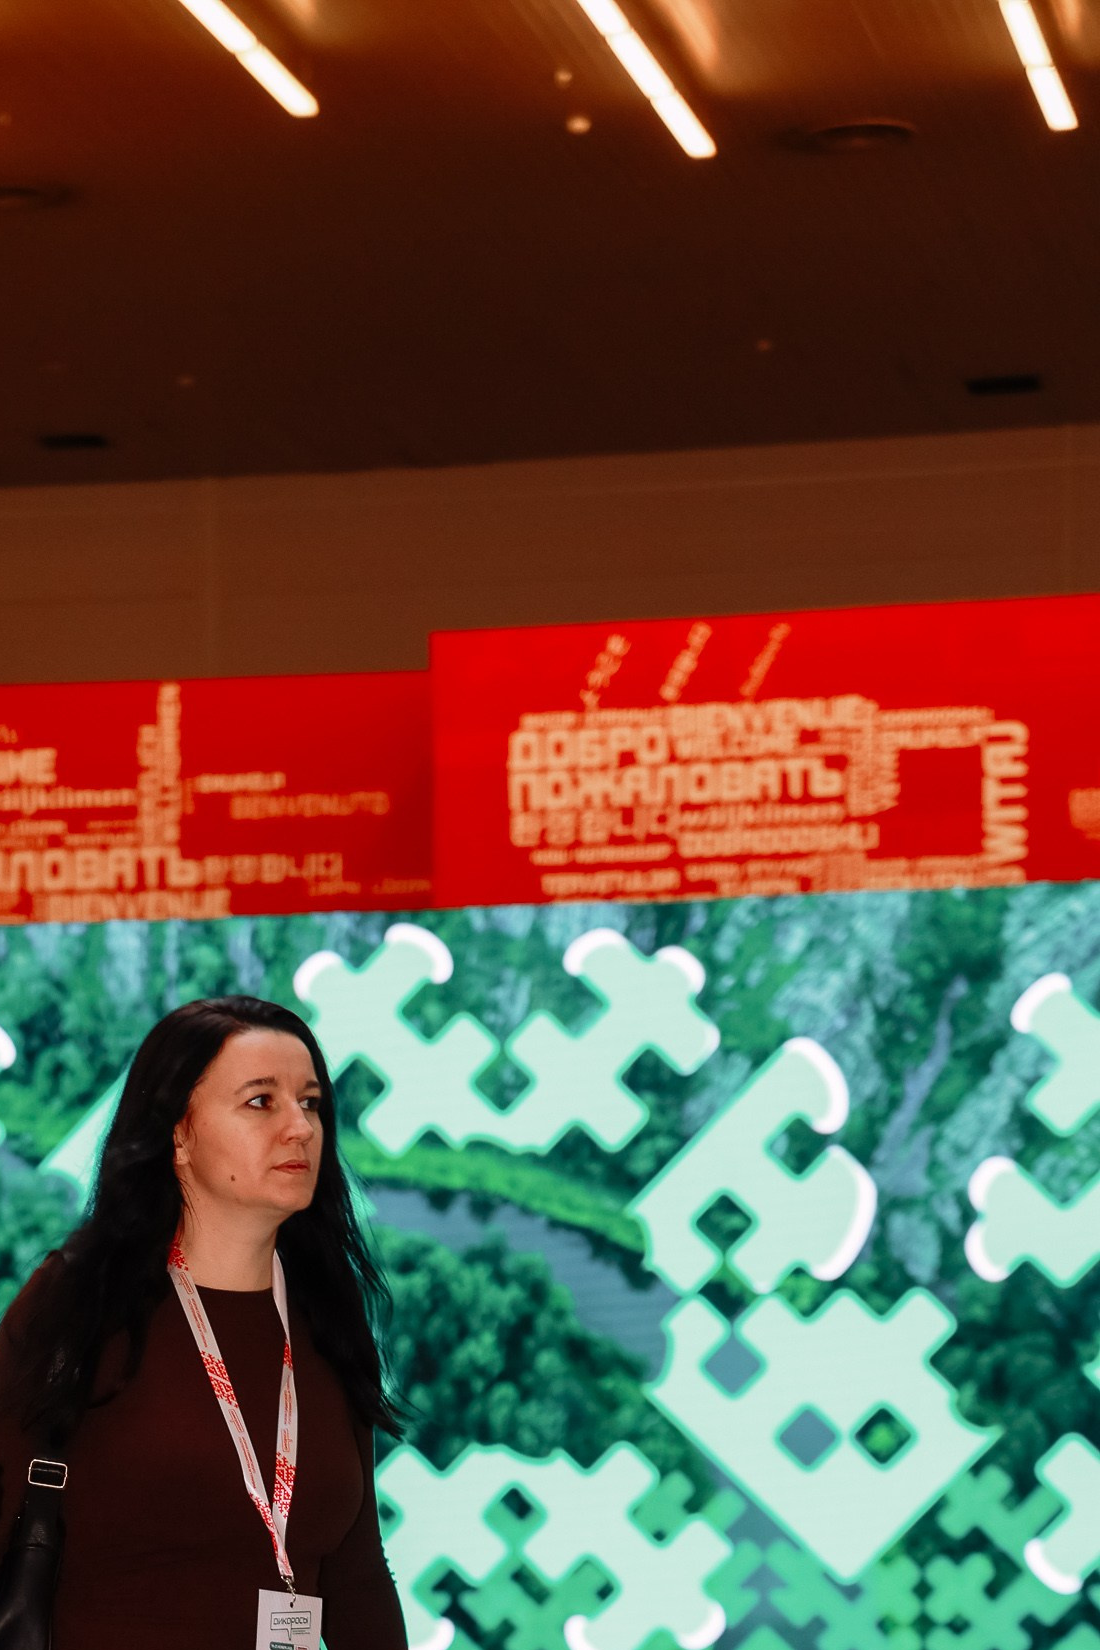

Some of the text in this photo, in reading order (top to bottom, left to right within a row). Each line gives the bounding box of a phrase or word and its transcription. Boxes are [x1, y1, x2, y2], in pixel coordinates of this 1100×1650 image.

[508, 726, 668, 769] ДОБРО
[508, 757, 844, 812] ПОЖАЛОВАТЬ
[273, 1616, 309, 1626] ДИКОРОСЫ
